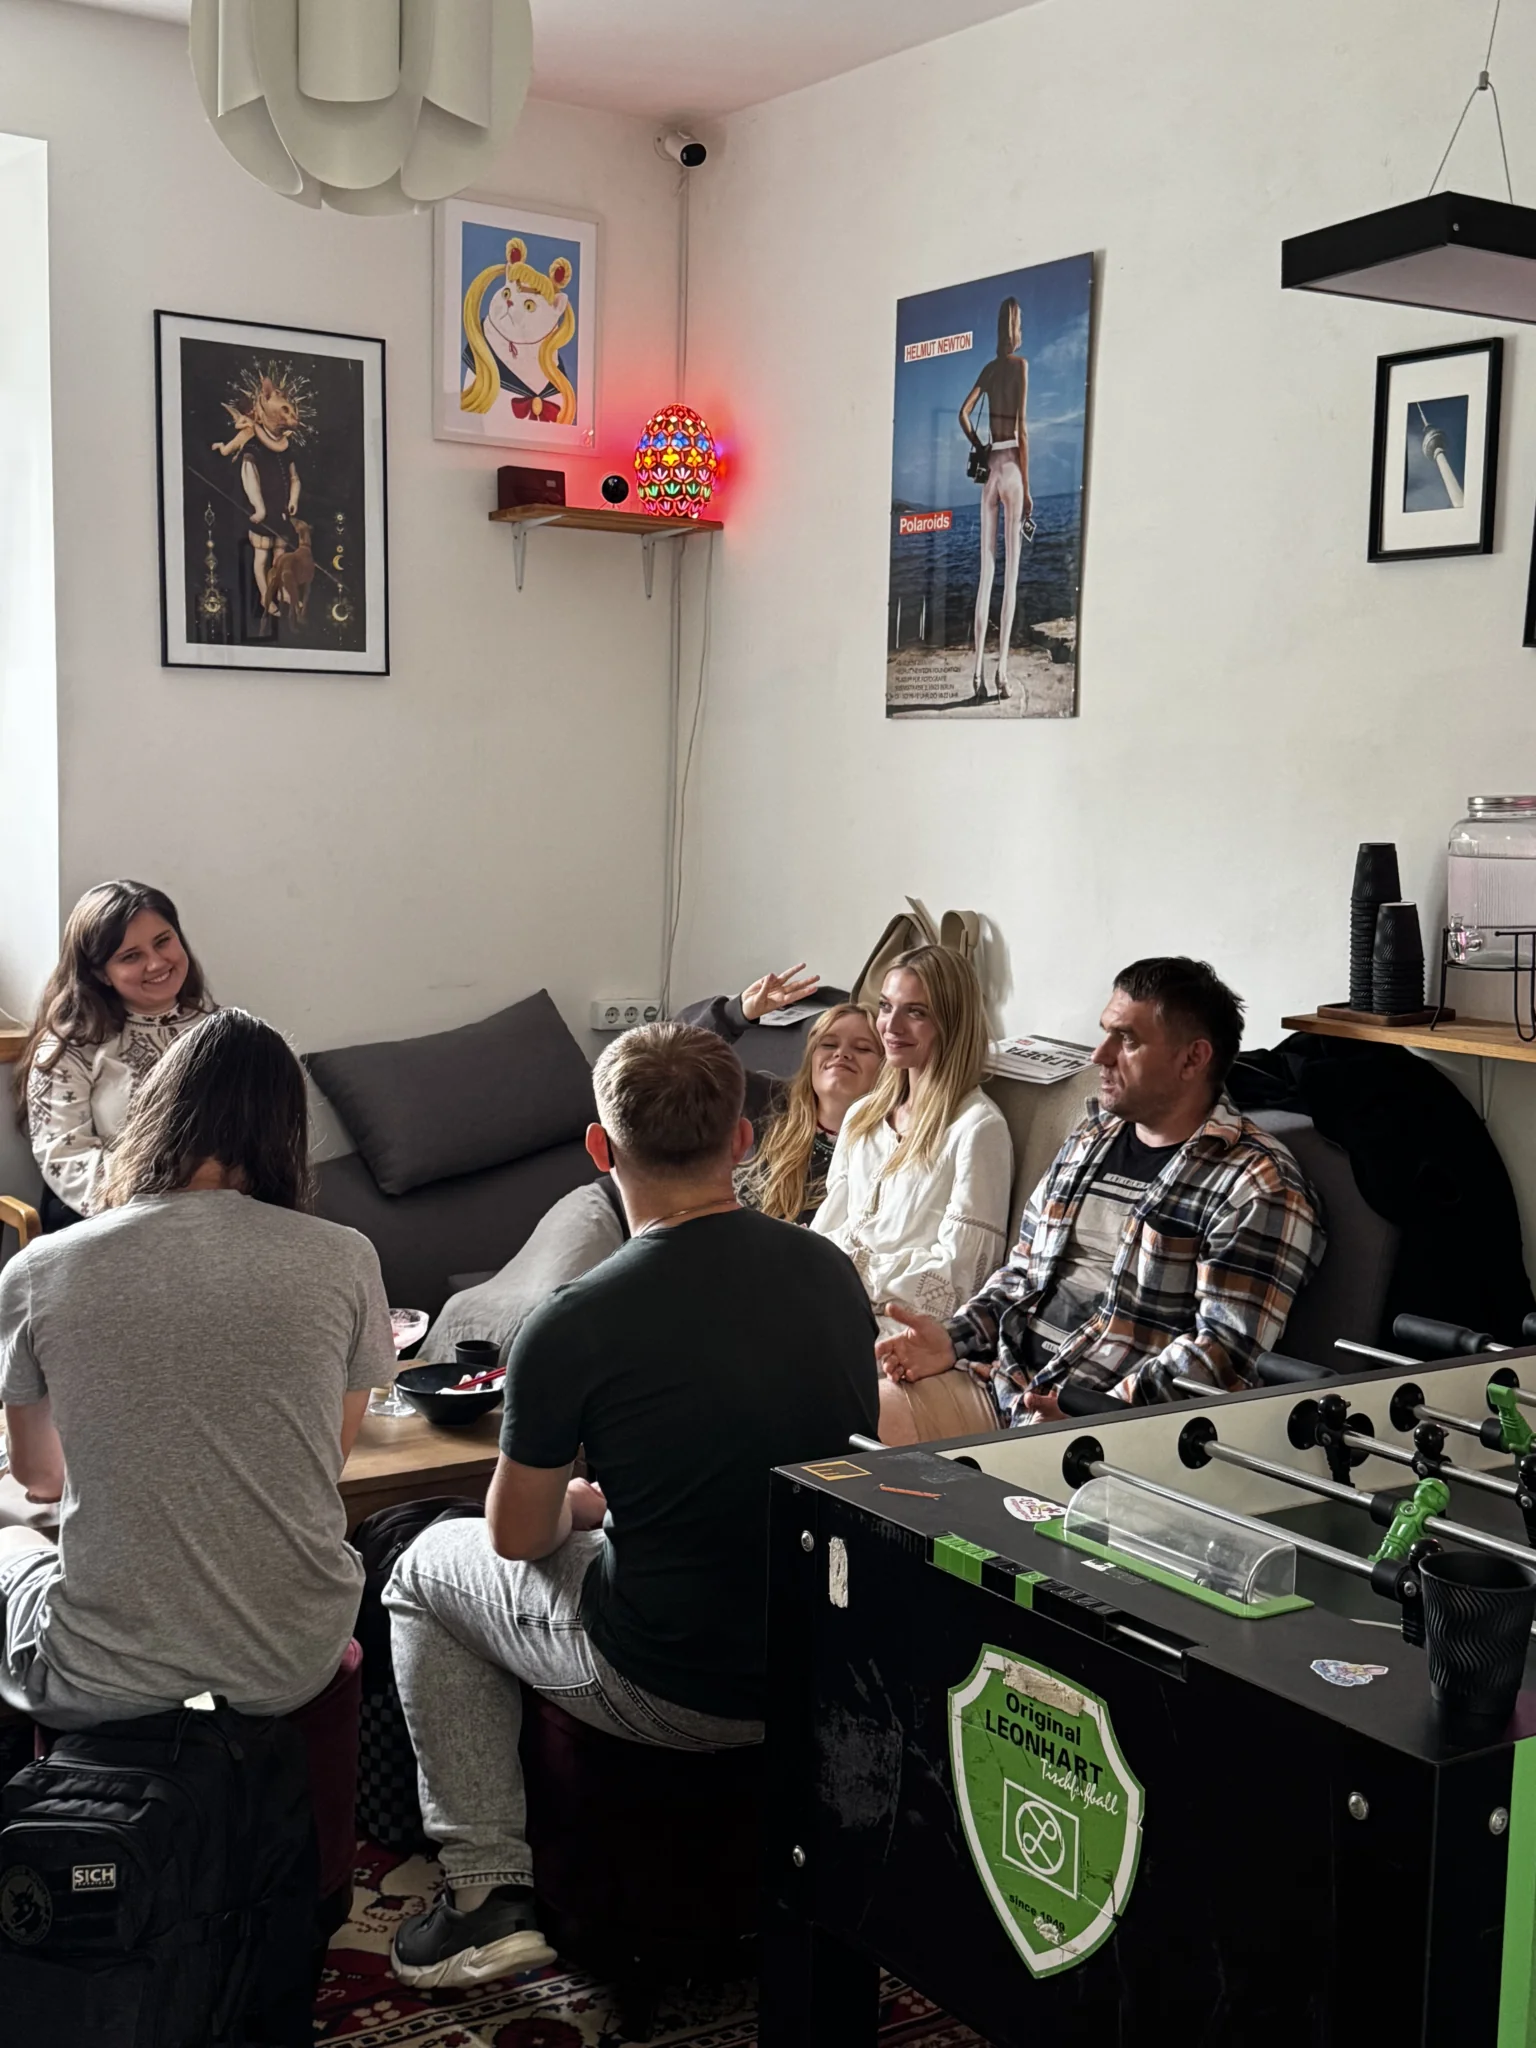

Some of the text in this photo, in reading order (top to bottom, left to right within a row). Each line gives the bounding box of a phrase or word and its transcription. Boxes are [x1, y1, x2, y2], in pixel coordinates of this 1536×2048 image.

[906, 333, 972, 361] HELMUT NEWTON
[900, 513, 950, 533] Polaroids
[1006, 1692, 1081, 1746] Original
[986, 1709, 1103, 1787] LEONHART
[75, 1868, 114, 1883] SICH
[1009, 1894, 1065, 1933] since 1949
